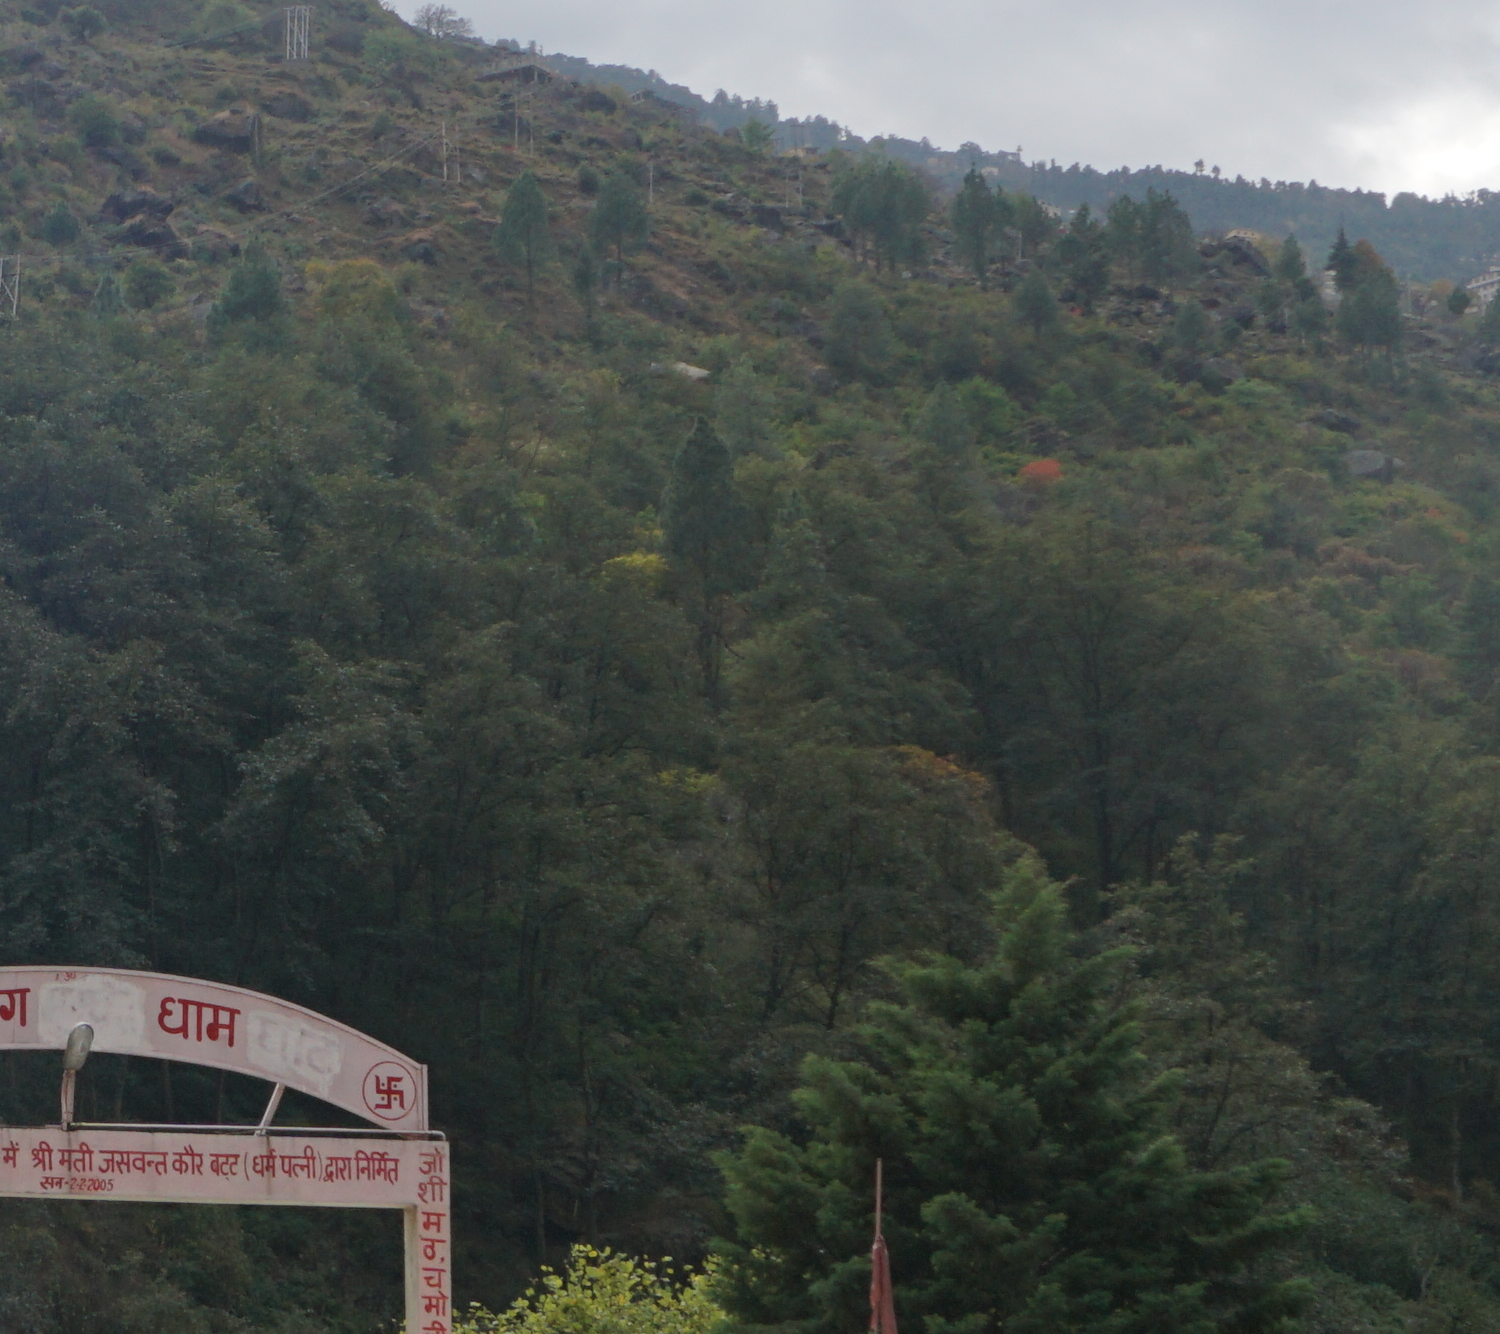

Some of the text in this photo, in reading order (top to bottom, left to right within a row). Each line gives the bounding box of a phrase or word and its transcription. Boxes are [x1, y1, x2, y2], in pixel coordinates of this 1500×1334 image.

[158, 996, 241, 1047] धाम
[1, 1139, 20, 1168] में
[31, 1141, 53, 1171] श्री
[57, 1142, 94, 1175] मती
[98, 1148, 168, 1177] जसवन्त
[172, 1144, 204, 1177] कौर
[324, 1155, 353, 1183] द्वारा
[354, 1149, 400, 1185] निर्मित
